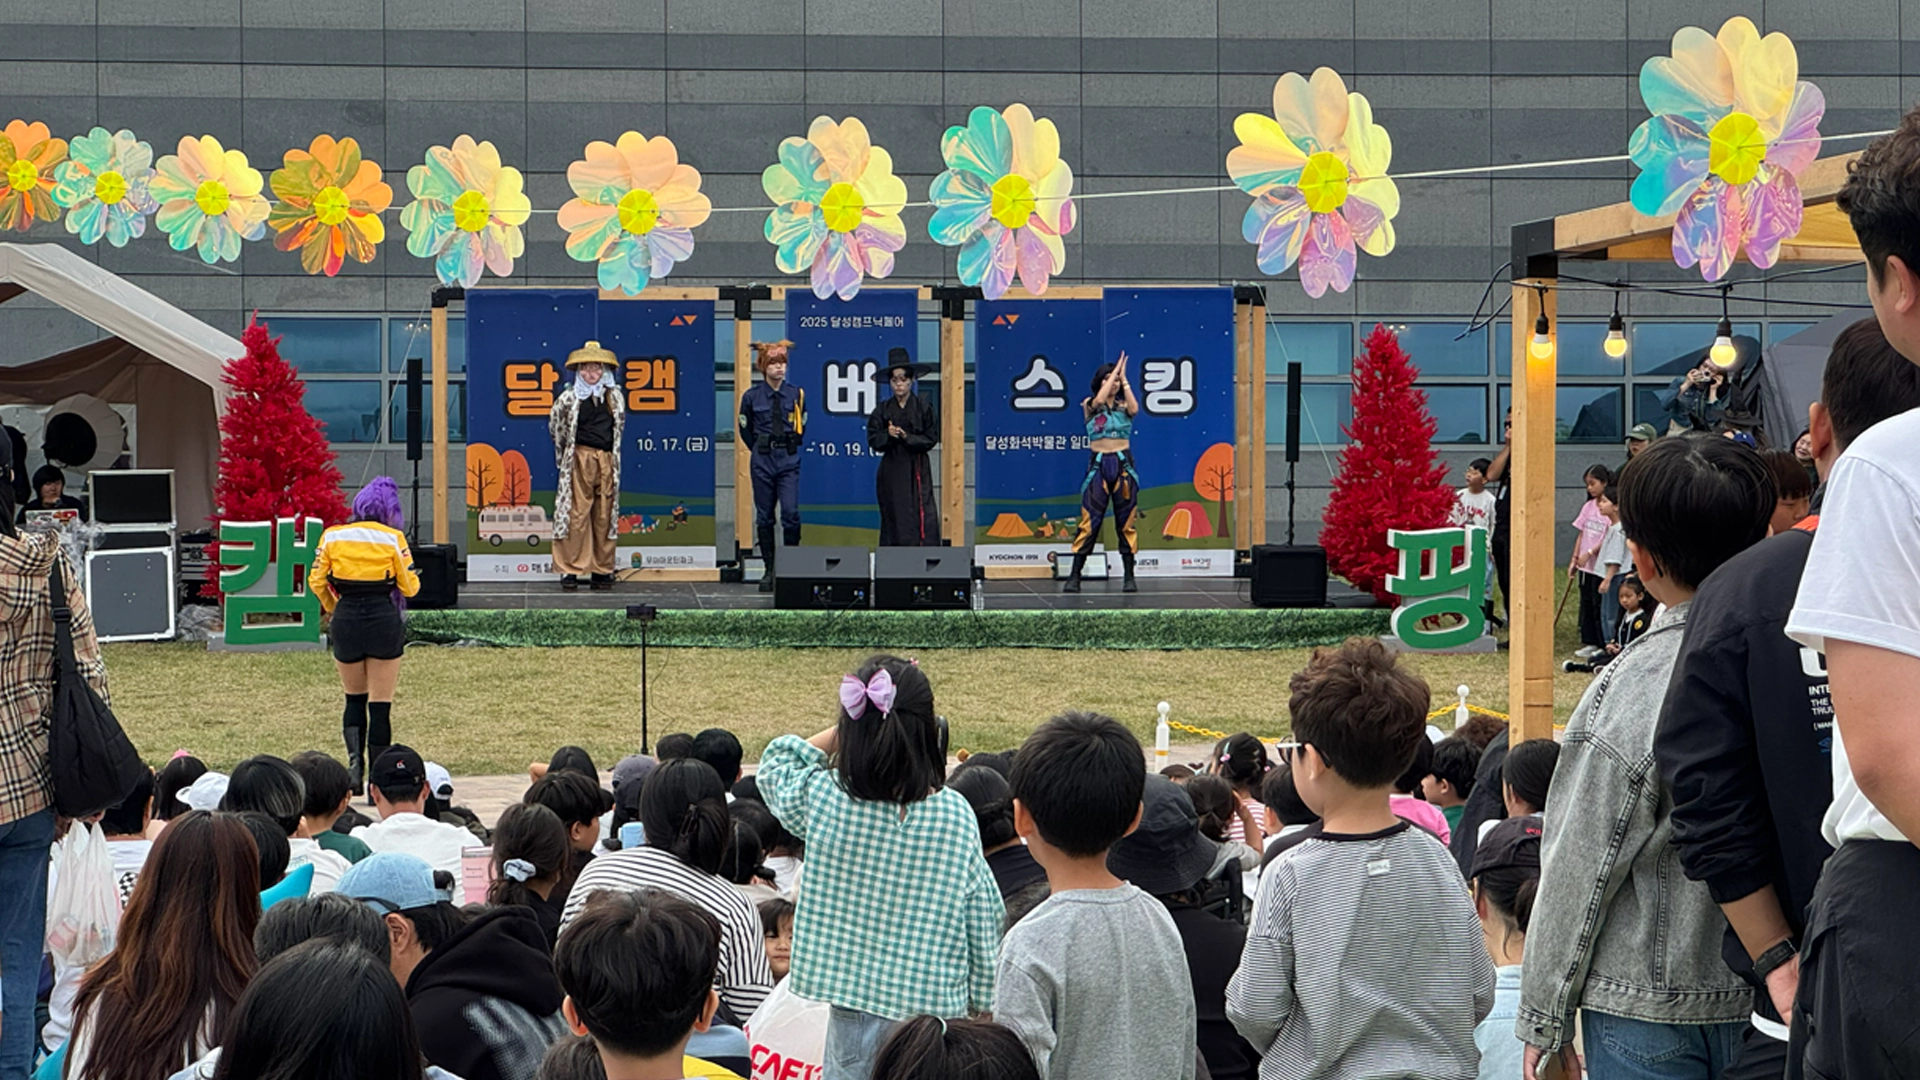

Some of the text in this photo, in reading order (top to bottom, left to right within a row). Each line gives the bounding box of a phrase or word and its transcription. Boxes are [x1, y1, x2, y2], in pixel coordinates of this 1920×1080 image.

[800, 316, 828, 328] 2025
[505, 359, 1194, 415] 달 캠 버 스 킹
[637, 436, 709, 452] 10. 17. (금)
[819, 442, 839, 456] 10.
[844, 442, 865, 456] 19.
[985, 435, 1066, 450] 달성화석박물관
[220, 516, 323, 645] 캠
